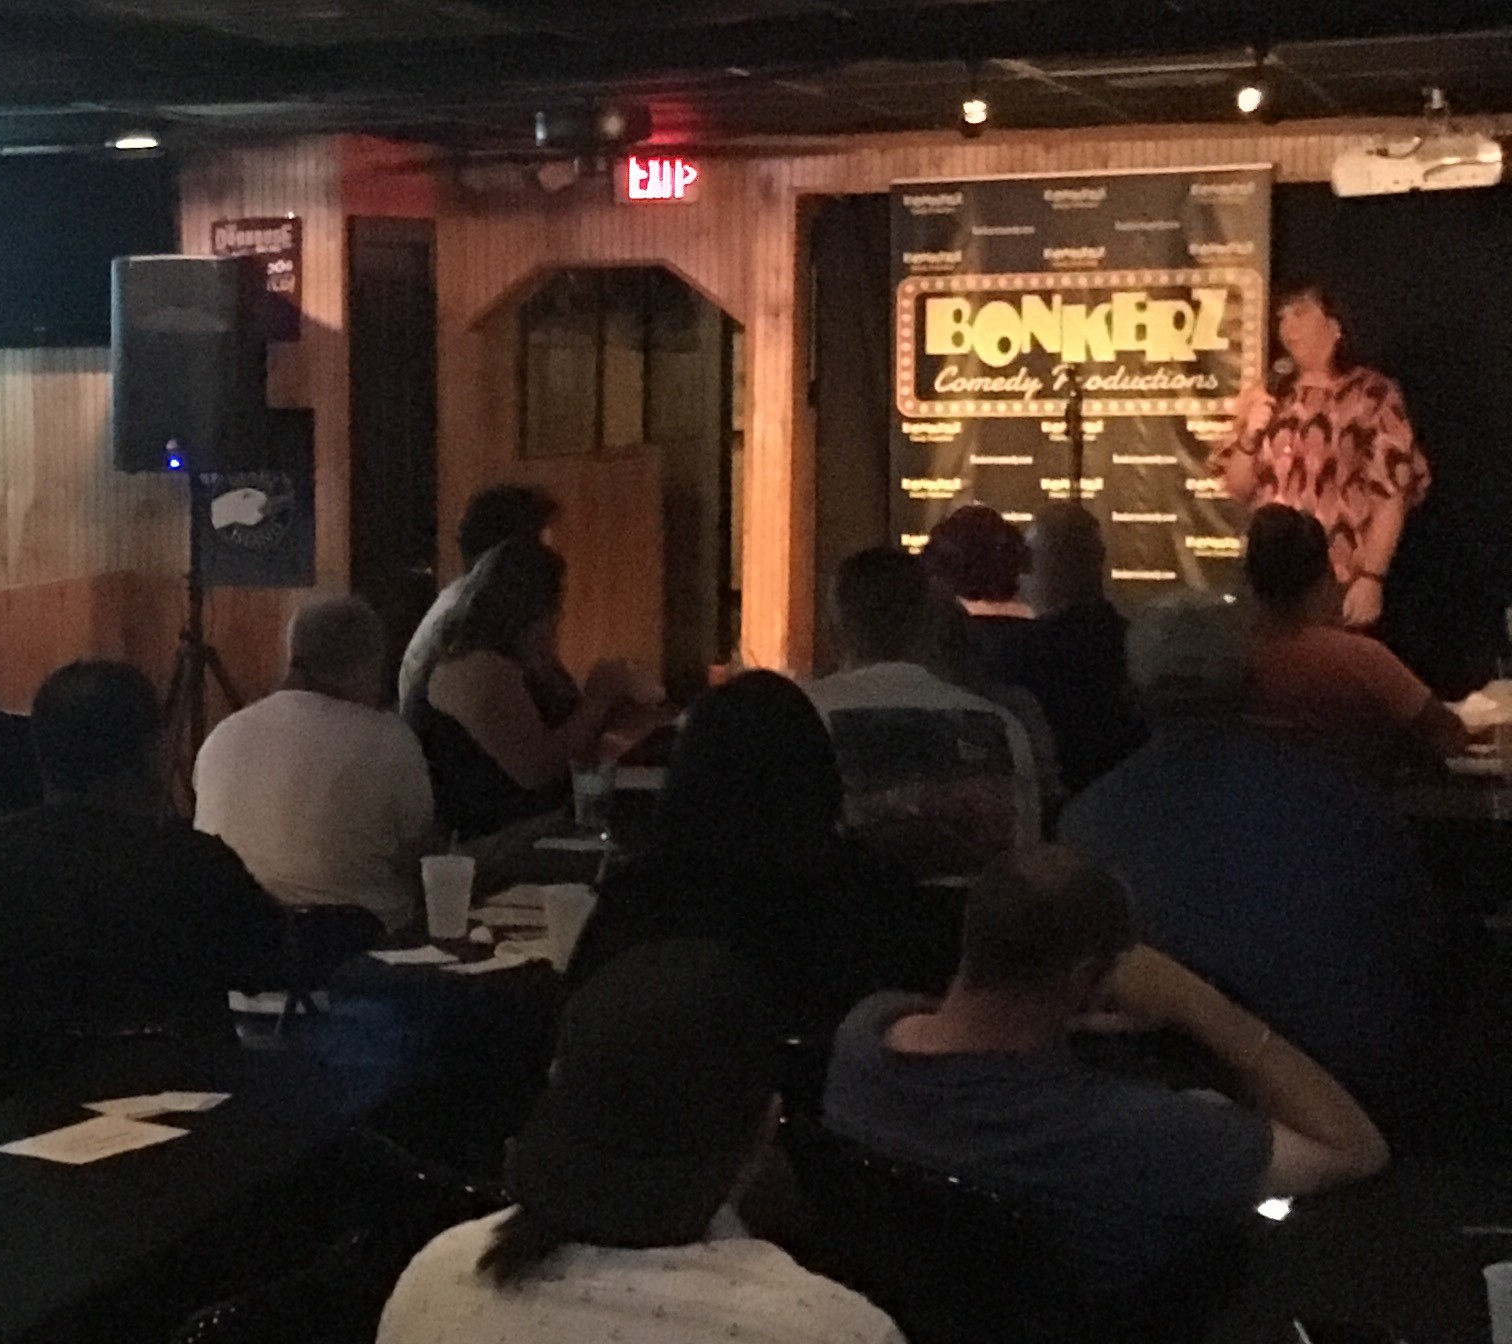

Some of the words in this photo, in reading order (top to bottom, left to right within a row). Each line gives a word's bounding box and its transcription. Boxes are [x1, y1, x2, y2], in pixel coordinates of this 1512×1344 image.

[925, 288, 1229, 368] BONKERZ
[934, 365, 1042, 399] Comedy
[1051, 364, 1219, 391] Poductions
